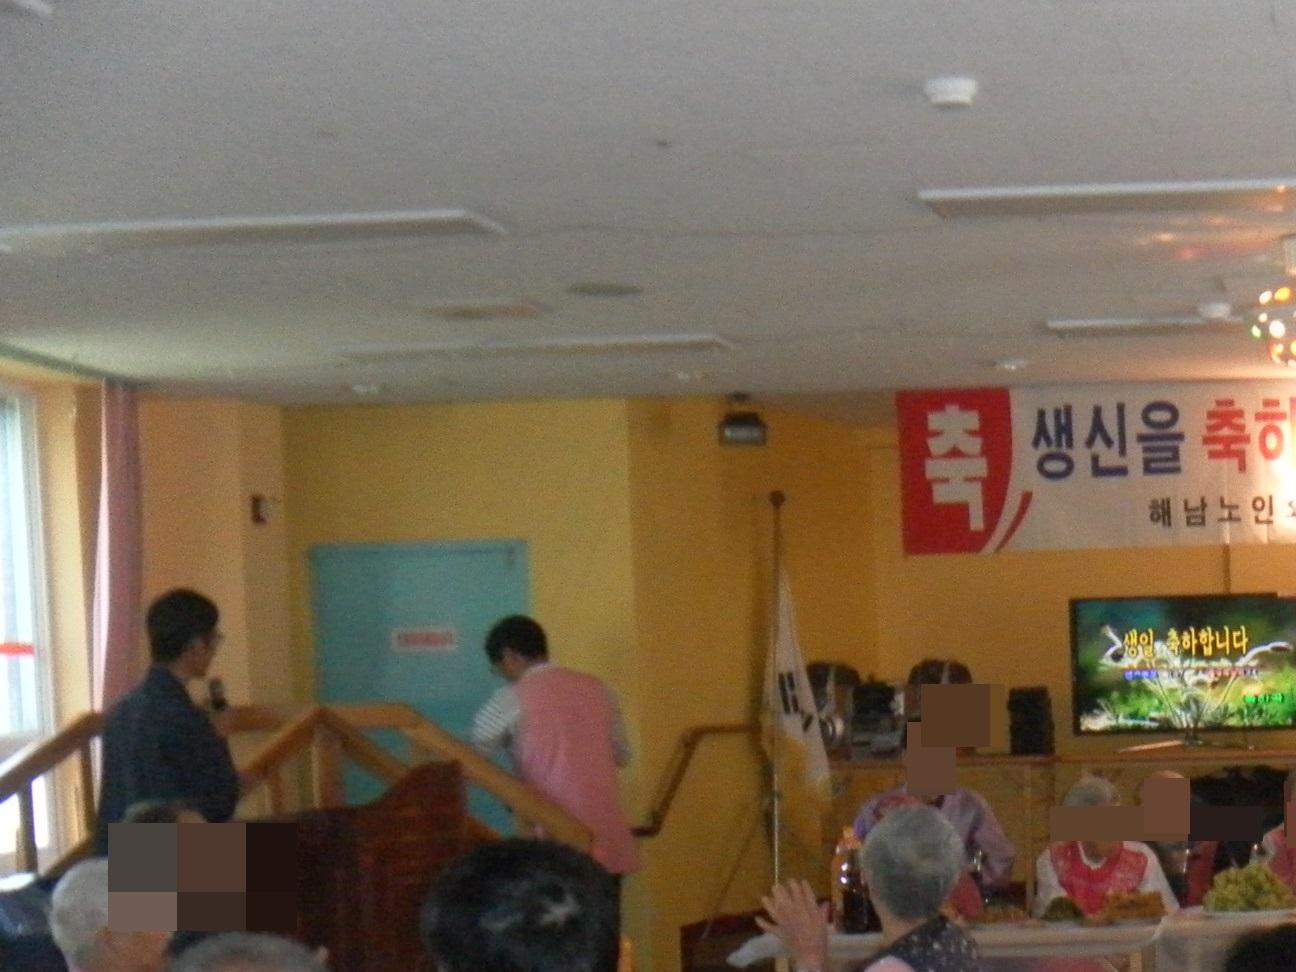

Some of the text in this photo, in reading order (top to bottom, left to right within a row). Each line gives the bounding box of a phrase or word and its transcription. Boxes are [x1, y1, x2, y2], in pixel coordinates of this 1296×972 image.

[925, 404, 987, 531] 축
[1031, 400, 1184, 479] 생신을
[1123, 625, 1248, 659] 생일 축하합니다
